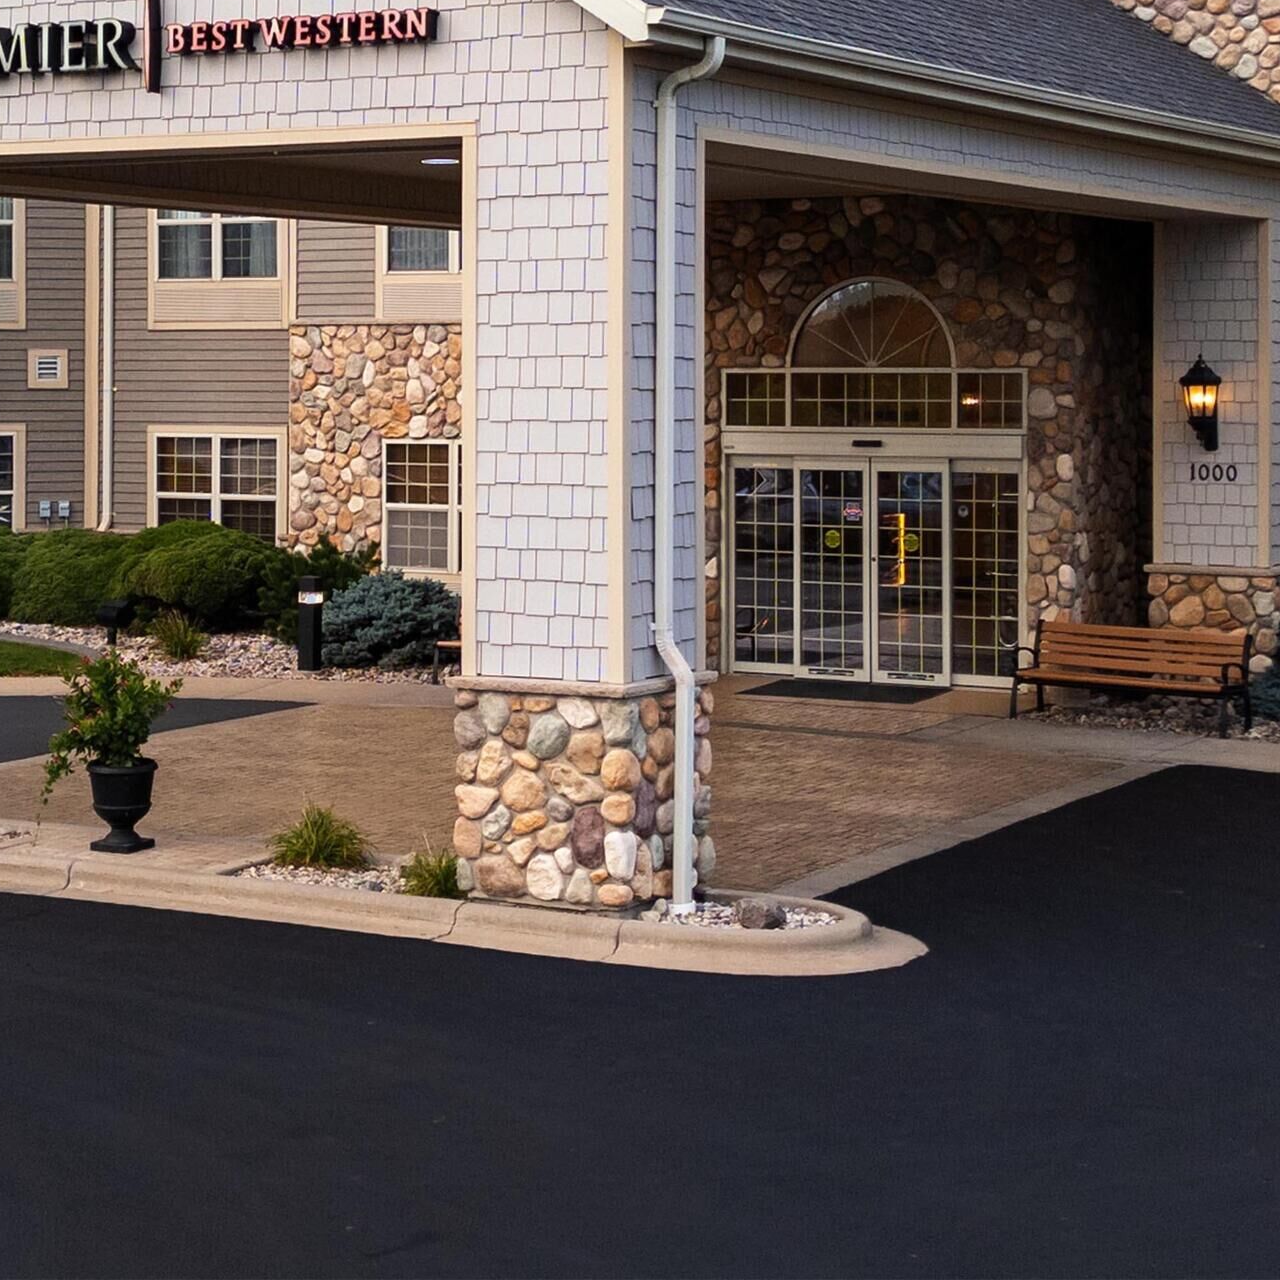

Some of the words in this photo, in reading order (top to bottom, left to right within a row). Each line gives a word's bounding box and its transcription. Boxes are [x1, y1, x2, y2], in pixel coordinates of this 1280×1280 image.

[166, 19, 250, 53] BEST
[258, 7, 431, 47] WESTERN
[1190, 463, 1238, 482] 1000
